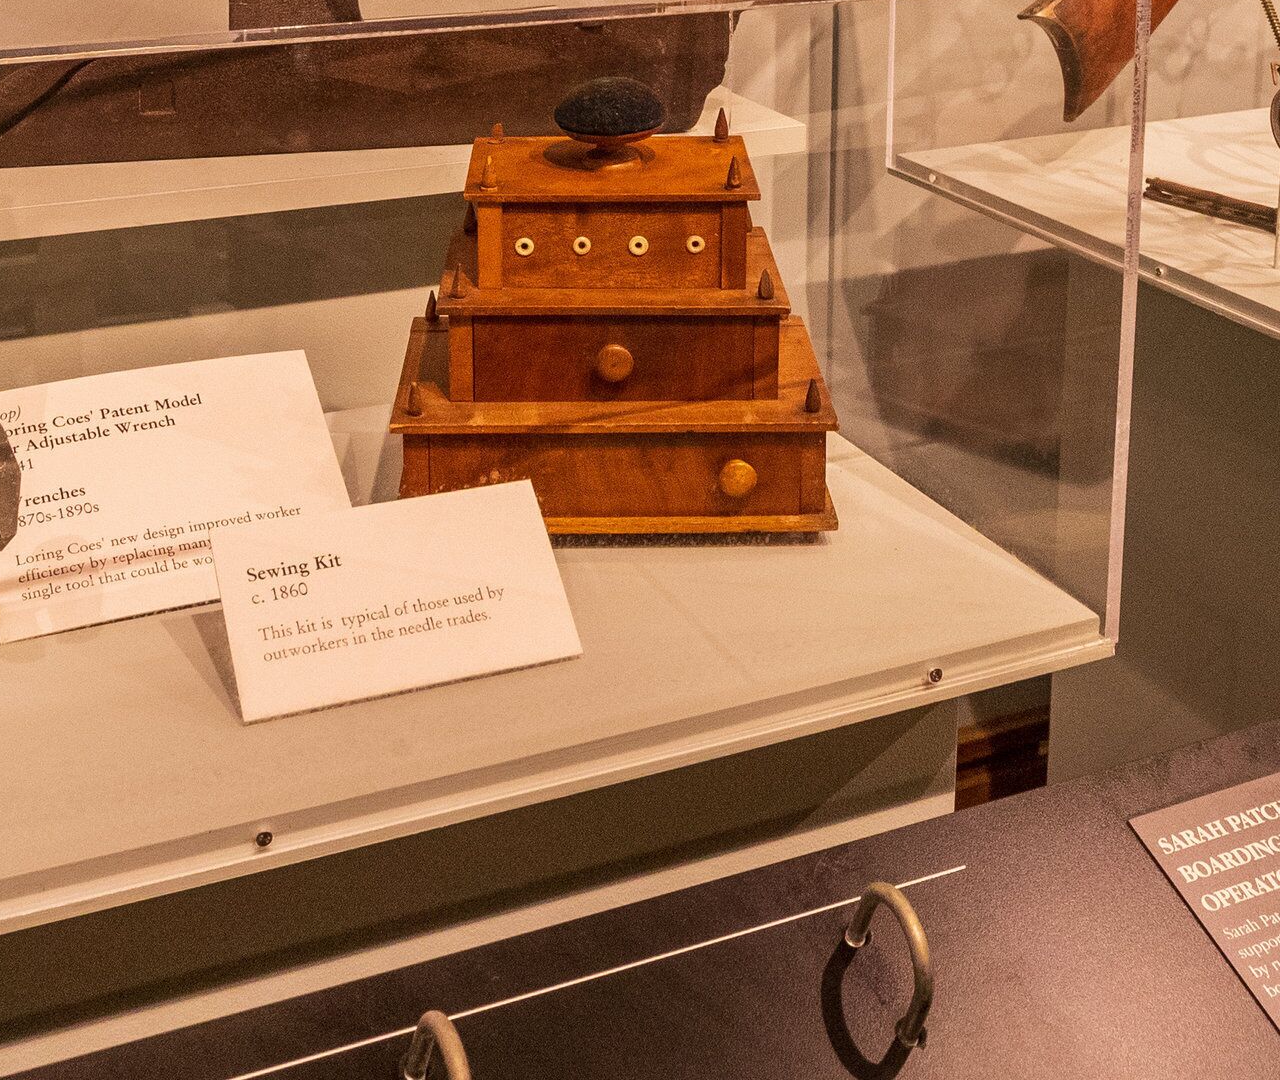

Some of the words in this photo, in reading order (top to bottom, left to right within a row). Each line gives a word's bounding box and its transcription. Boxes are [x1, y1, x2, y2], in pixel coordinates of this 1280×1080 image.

[8, 422, 48, 436] oring
[52, 410, 93, 427] Coes'
[99, 403, 150, 420] Patent
[154, 393, 202, 411] Model
[26, 425, 110, 451] Adjustable
[114, 414, 176, 434] Wrench
[19, 502, 100, 527] 870s-1890s
[25, 487, 86, 507] renches
[15, 548, 64, 566] Loring
[66, 537, 104, 554] Coes'
[110, 534, 138, 547] new
[142, 526, 185, 541] design
[188, 510, 252, 532] improved
[255, 505, 301, 520] worker
[17, 562, 85, 584] efficiency
[89, 556, 107, 569] by
[112, 545, 176, 565] replacing
[21, 582, 61, 601] single
[65, 574, 94, 591] tool
[98, 571, 126, 585] that
[130, 560, 169, 578] could
[171, 558, 188, 570] be
[246, 561, 310, 582] Sewing
[314, 553, 342, 570] Kit
[251, 594, 265, 605] c.
[271, 581, 308, 601] 1860
[257, 623, 293, 641] This
[295, 619, 317, 635] kit
[320, 616, 333, 630] is
[340, 604, 390, 629] typical
[393, 600, 408, 616] of
[412, 598, 449, 613] those
[452, 587, 484, 605] used
[485, 585, 504, 601] by
[263, 637, 349, 662] outworkers
[351, 631, 367, 645] in
[370, 626, 394, 641] the
[398, 616, 442, 636] needle
[446, 609, 491, 627] trades.
[1157, 819, 1229, 855] SARAH
[1222, 918, 1261, 939] Sarah
[1247, 964, 1270, 978] by
